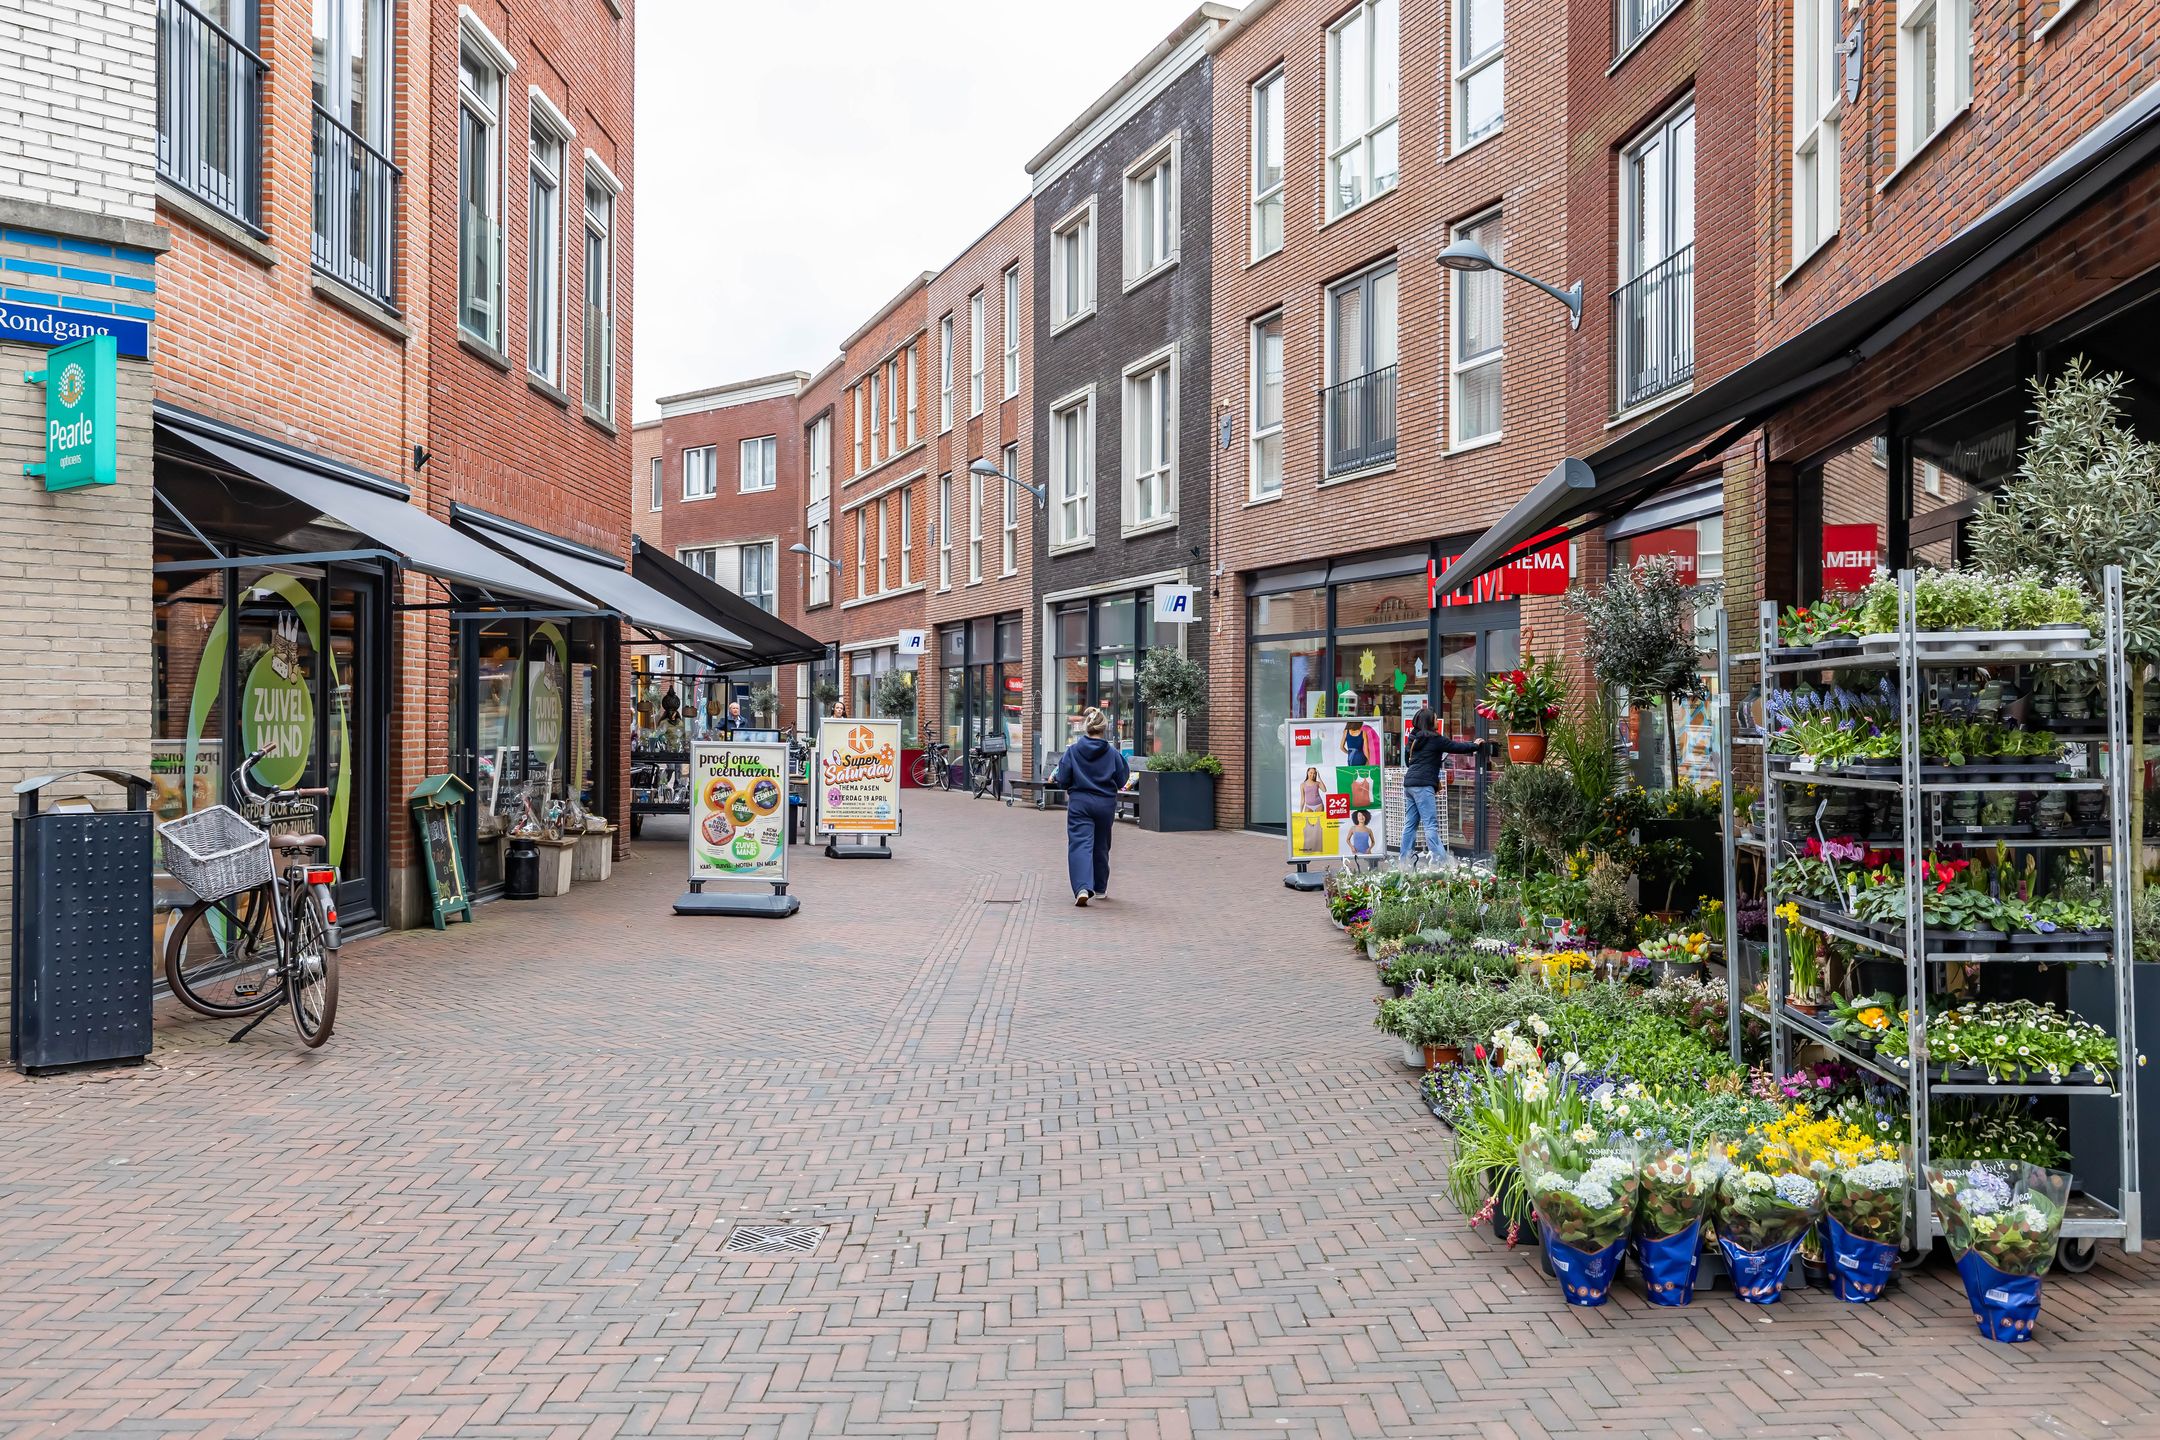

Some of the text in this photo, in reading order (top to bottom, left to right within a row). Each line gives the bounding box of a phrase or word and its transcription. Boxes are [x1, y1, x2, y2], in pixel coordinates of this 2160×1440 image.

[50, 412, 93, 452] Pearle
[60, 454, 82, 469] opticiens
[254, 687, 306, 722] ZUIVEL
[535, 696, 559, 720] ZUIVEL
[536, 720, 558, 743] MAND
[699, 751, 760, 768] proef onze
[843, 754, 880, 769] Super
[709, 765, 780, 778] veenkazen!
[825, 764, 894, 784] Saturday
[1329, 798, 1347, 808] 2+2
[1329, 808, 1348, 816] gratis
[736, 848, 757, 856] MAND
